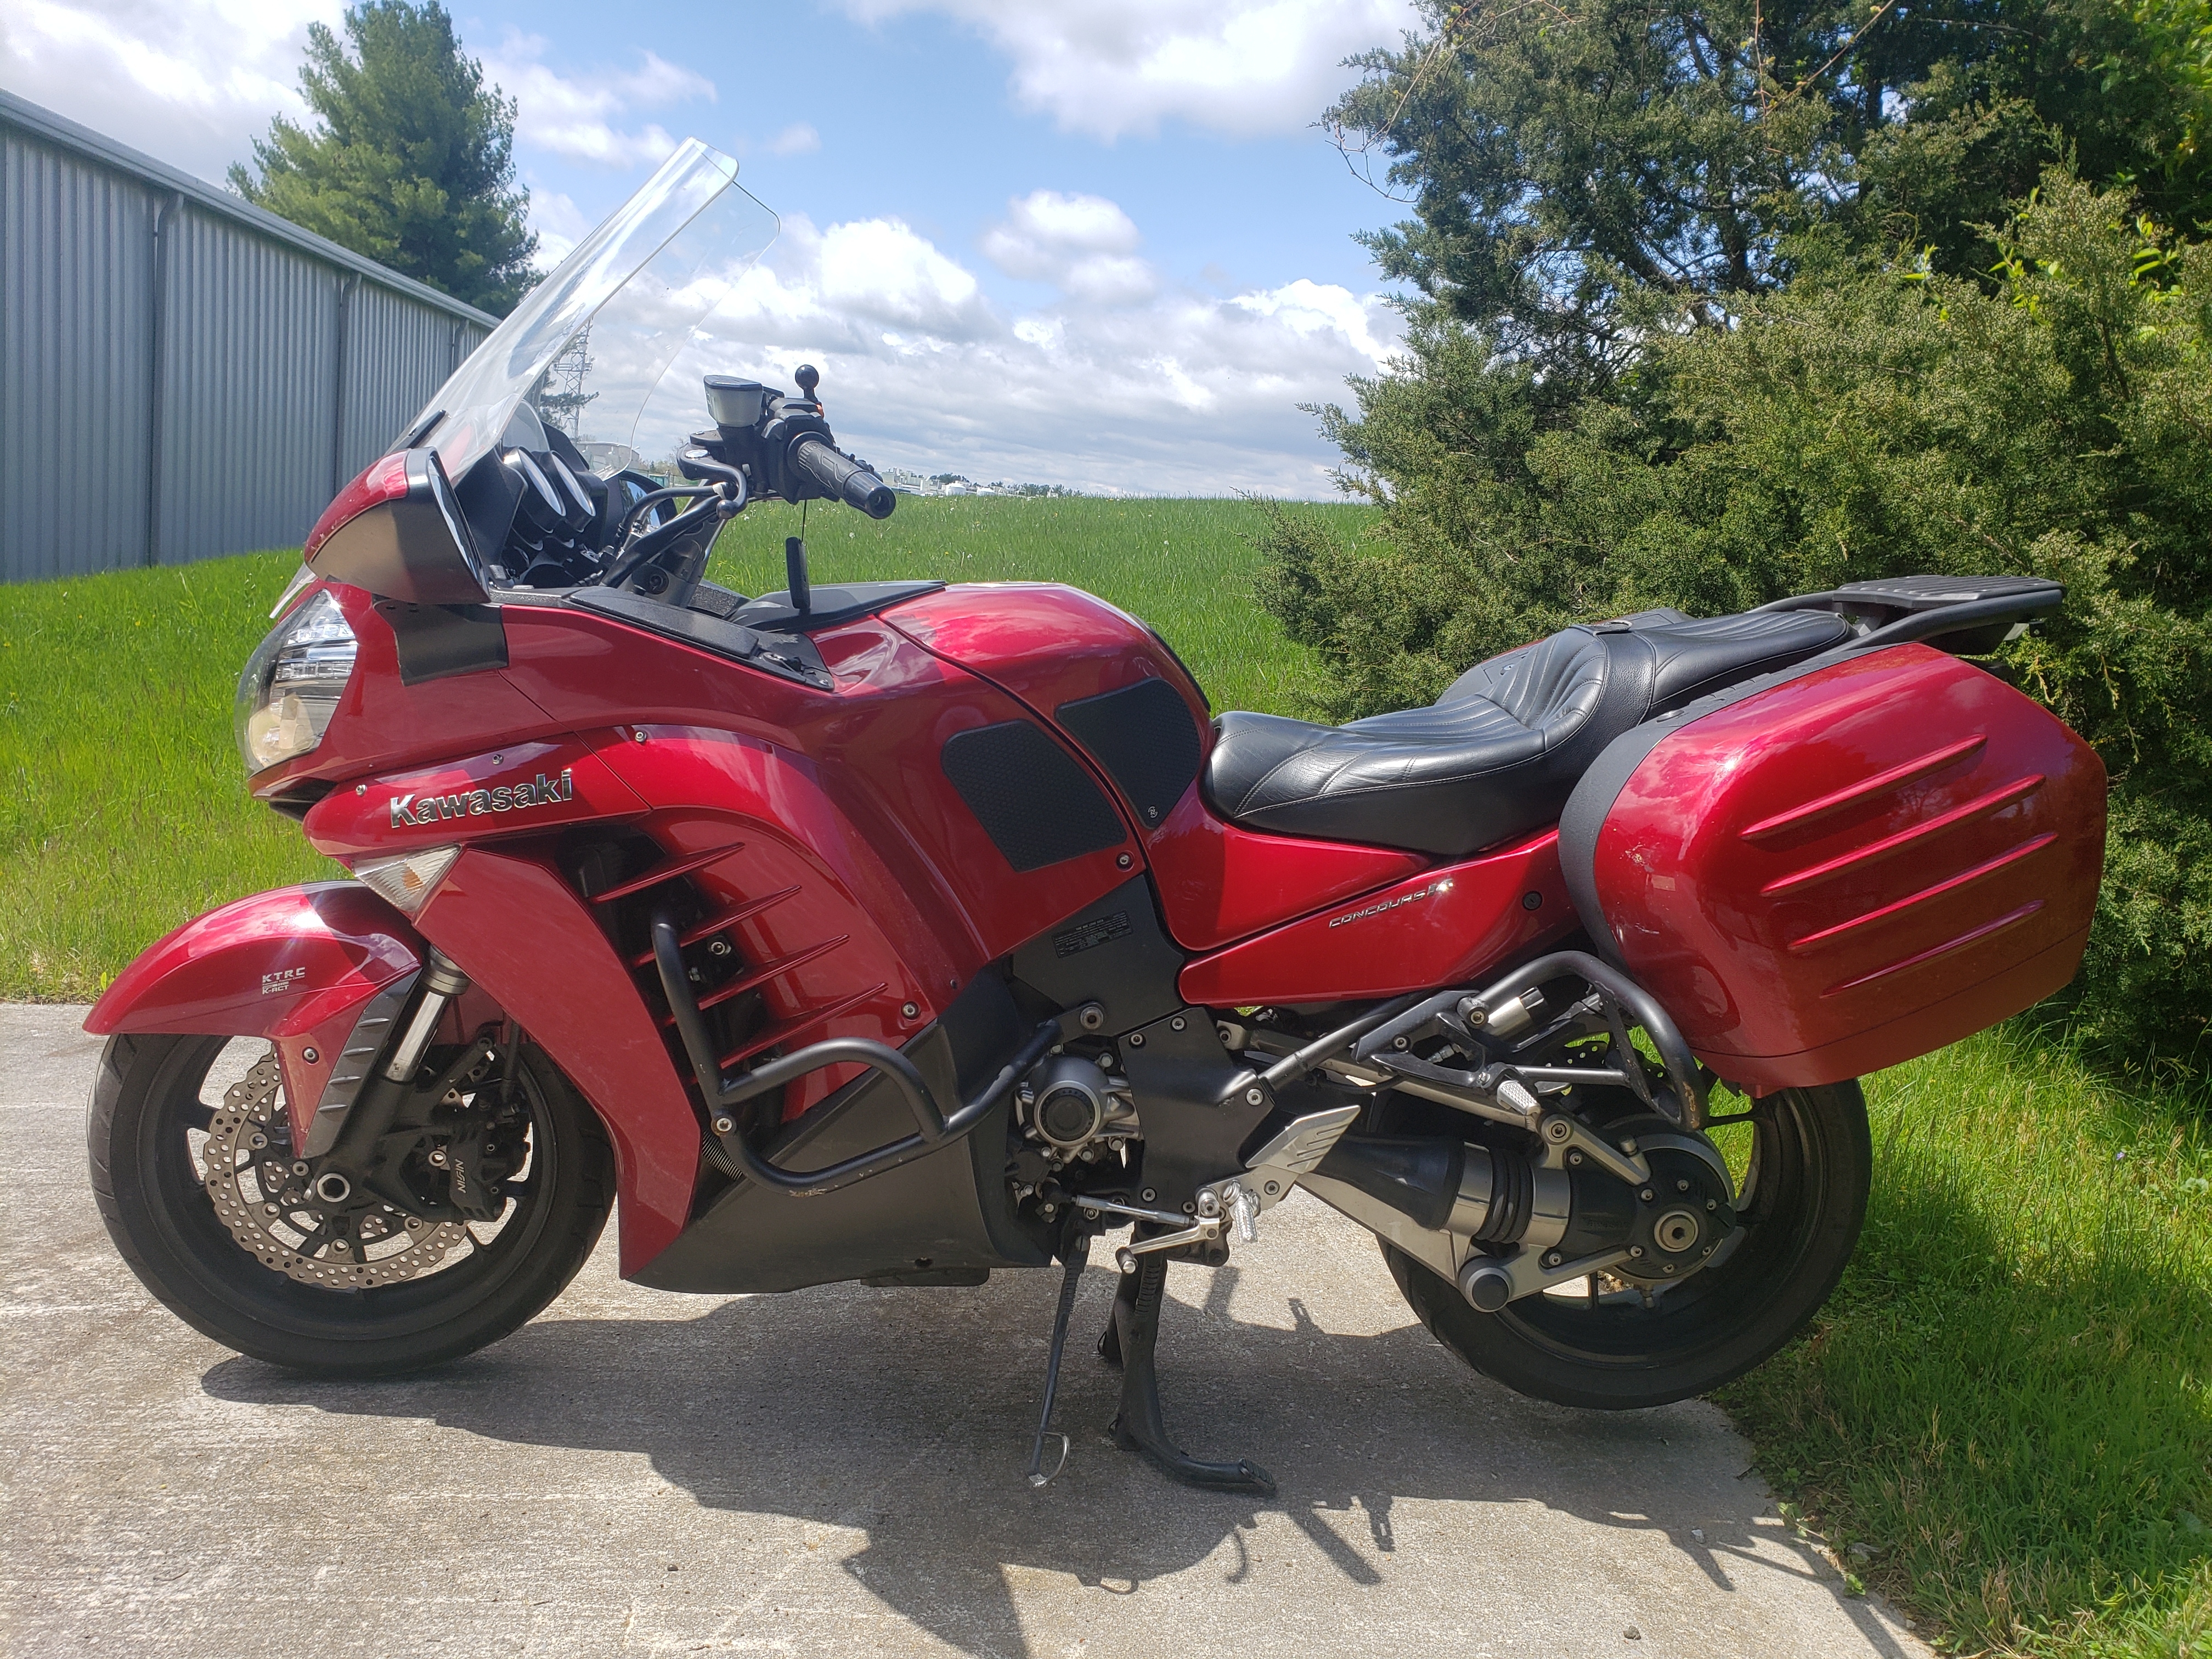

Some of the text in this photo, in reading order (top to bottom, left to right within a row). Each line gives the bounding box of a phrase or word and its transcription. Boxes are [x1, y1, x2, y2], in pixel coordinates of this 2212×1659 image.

[390, 768, 572, 828] Kawasaki
[1329, 889, 1426, 928] CONCOURS
[262, 967, 306, 983] KTRC
